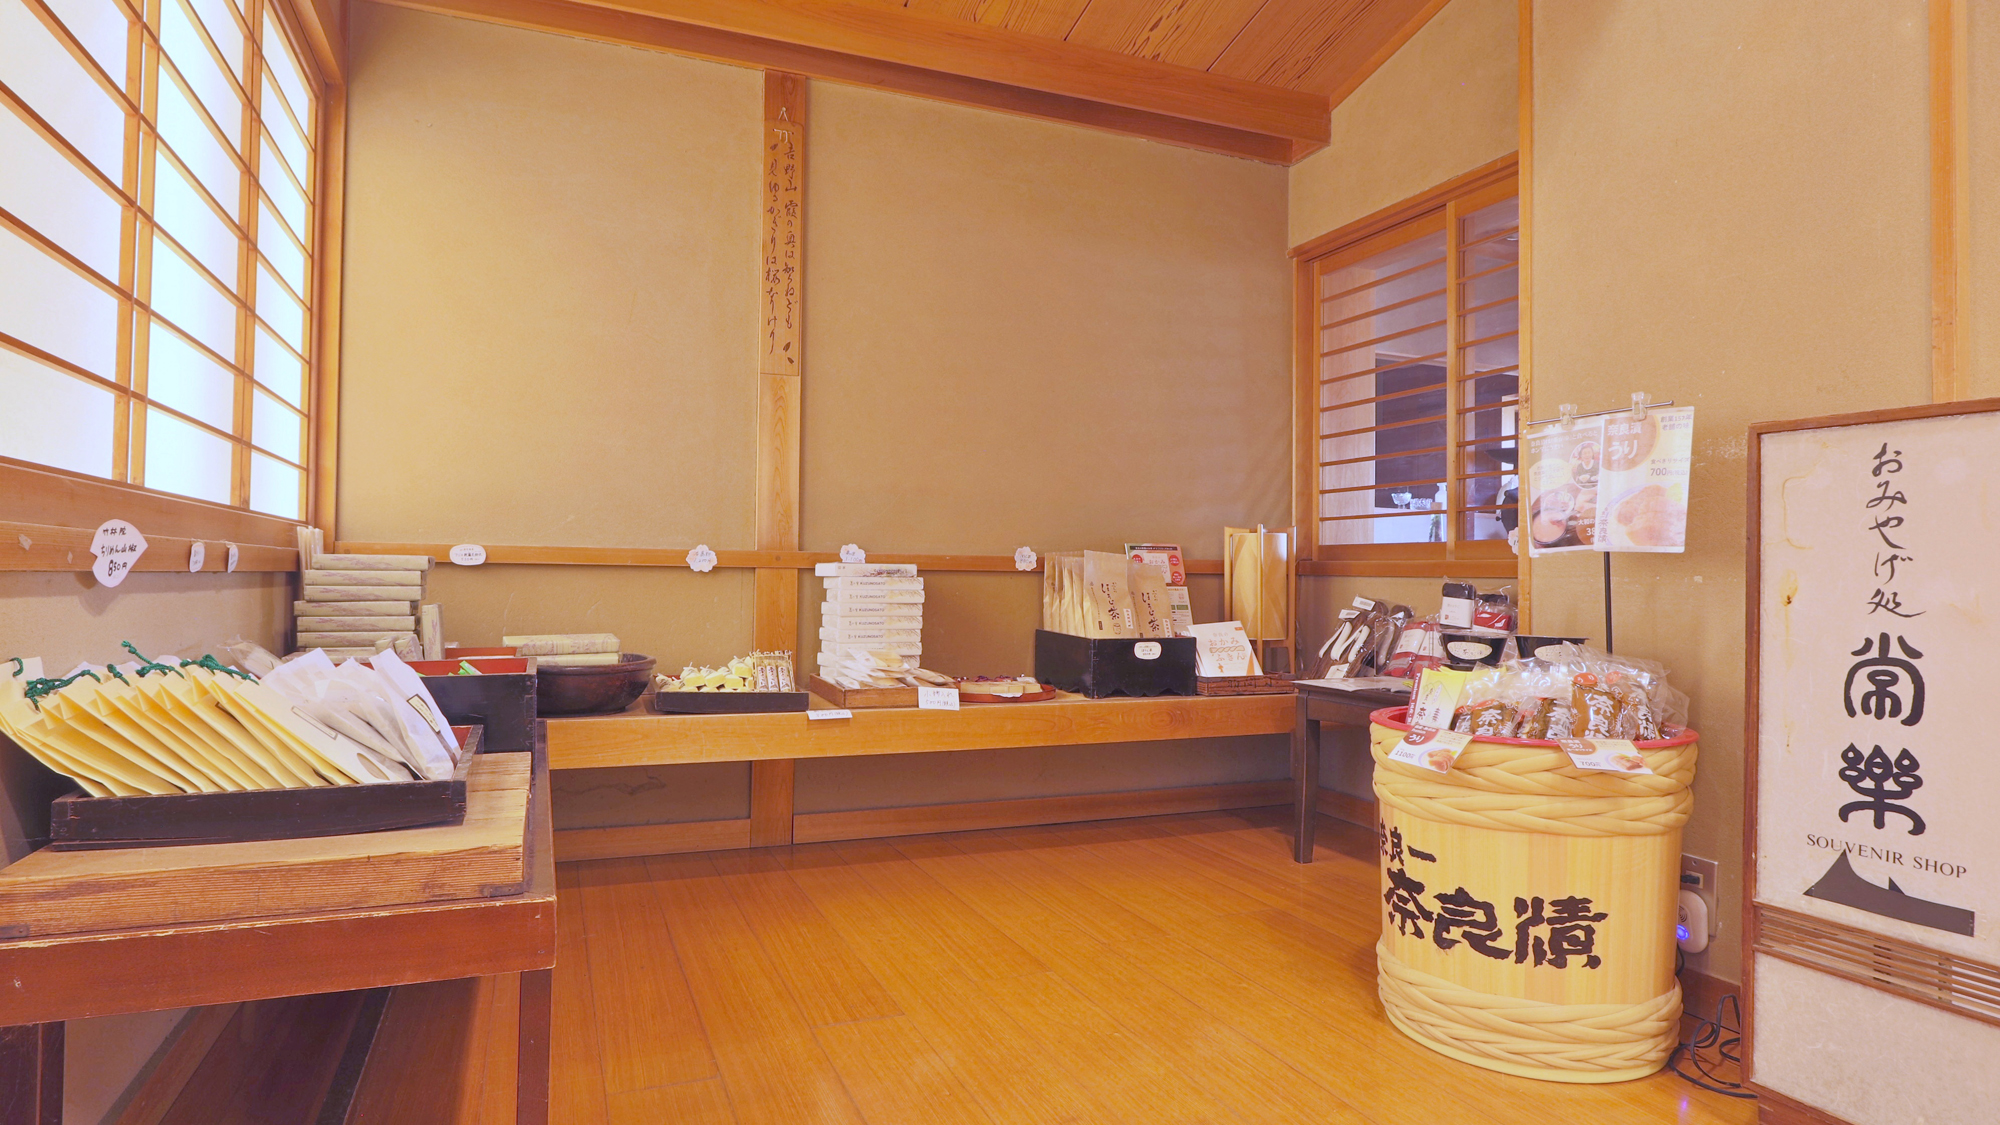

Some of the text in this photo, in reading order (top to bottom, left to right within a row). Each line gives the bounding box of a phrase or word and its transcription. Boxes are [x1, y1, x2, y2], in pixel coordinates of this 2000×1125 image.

[1607, 423, 1642, 436] 奈良漬
[1608, 440, 1638, 460] うり
[1866, 442, 1926, 618] おみやげ処
[100, 544, 138, 558] ちりめん山椒
[107, 559, 128, 577] 850円
[1101, 583, 1119, 620] ほうじ茶
[1141, 592, 1160, 632] ほうじ茶
[1208, 637, 1239, 646] おかみ
[1806, 833, 1968, 880] SOUVENIR SHOP
[1384, 867, 1609, 969] 奈良漬
